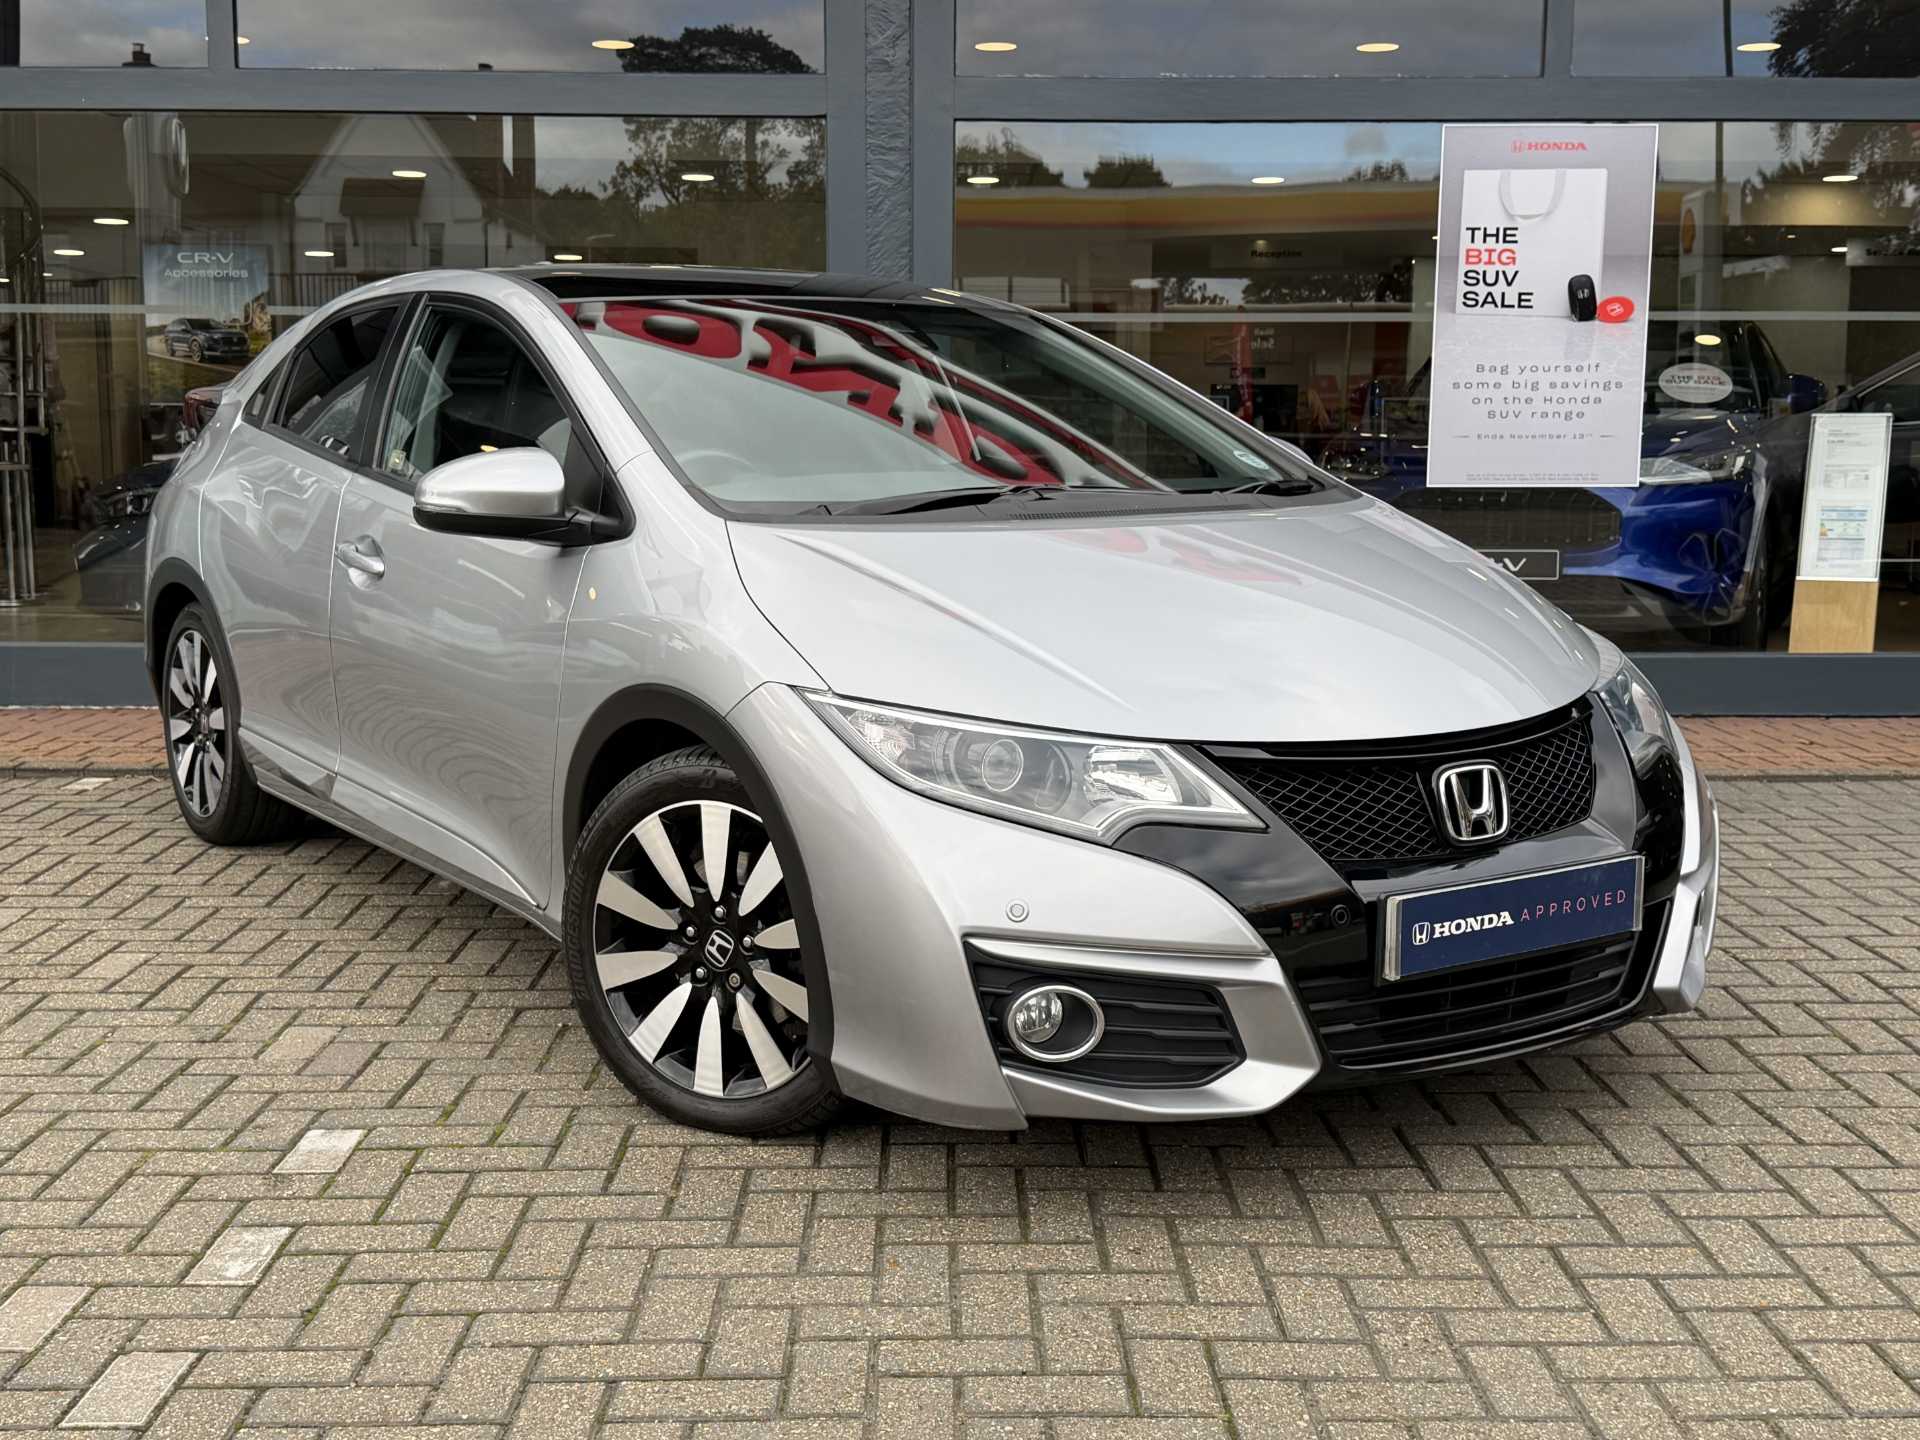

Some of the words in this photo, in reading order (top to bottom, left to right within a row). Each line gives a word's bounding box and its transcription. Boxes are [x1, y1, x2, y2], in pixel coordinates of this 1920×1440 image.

[1527, 141, 1588, 151] HONDA
[1465, 227, 1519, 244] THE
[1464, 248, 1517, 266] BIG
[164, 267, 249, 279] Accessories
[1462, 270, 1520, 287] SUV
[1462, 291, 1534, 309] SALE
[1475, 363, 1510, 376] Bag
[1518, 362, 1601, 376] yourself
[1452, 380, 1503, 391] some
[1511, 379, 1540, 392] big
[1549, 379, 1624, 392] savings
[1471, 396, 1494, 406] on
[1503, 395, 1534, 406] the
[1543, 395, 1603, 406] Honda
[1486, 409, 1523, 420] SUV
[1530, 410, 1586, 422] range
[1477, 432, 1505, 440] Ends
[1509, 432, 1568, 440] November
[1432, 911, 1516, 939] HONDA
[1520, 888, 1627, 922] APPROVED
[566, 863, 589, 1002] BRIDGESTONE
